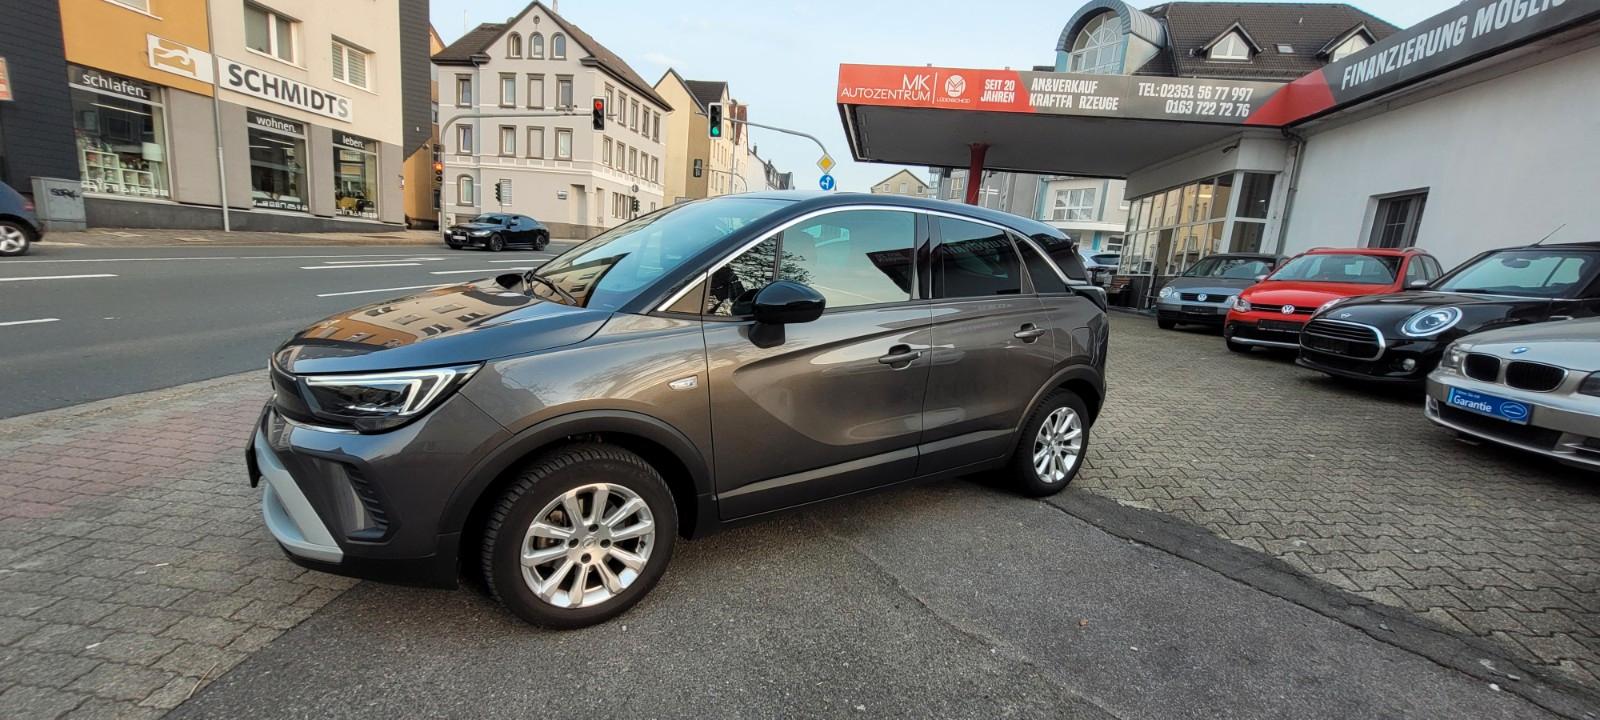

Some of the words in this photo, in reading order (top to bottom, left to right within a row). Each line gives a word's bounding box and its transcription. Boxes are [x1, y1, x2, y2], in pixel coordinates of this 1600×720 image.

[1341, 15, 1468, 91] FINANZIERUNG
[228, 63, 349, 118] SCHMIDTS
[902, 73, 930, 91] MK
[984, 79, 1003, 91] SEIT
[1003, 79, 1016, 91] 20
[1031, 78, 1099, 94] AN&VERKAUF
[841, 87, 931, 102] AUTOZENTRUM
[980, 90, 1016, 104] JAHREN
[1198, 85, 1213, 99] 56
[1214, 86, 1230, 100] 77
[1231, 87, 1254, 102] 997
[1165, 99, 1194, 114] 0163
[1195, 101, 1217, 115] 722
[1218, 102, 1233, 116] 72
[1235, 103, 1251, 117] 76
[1453, 394, 1492, 413] Garantie
